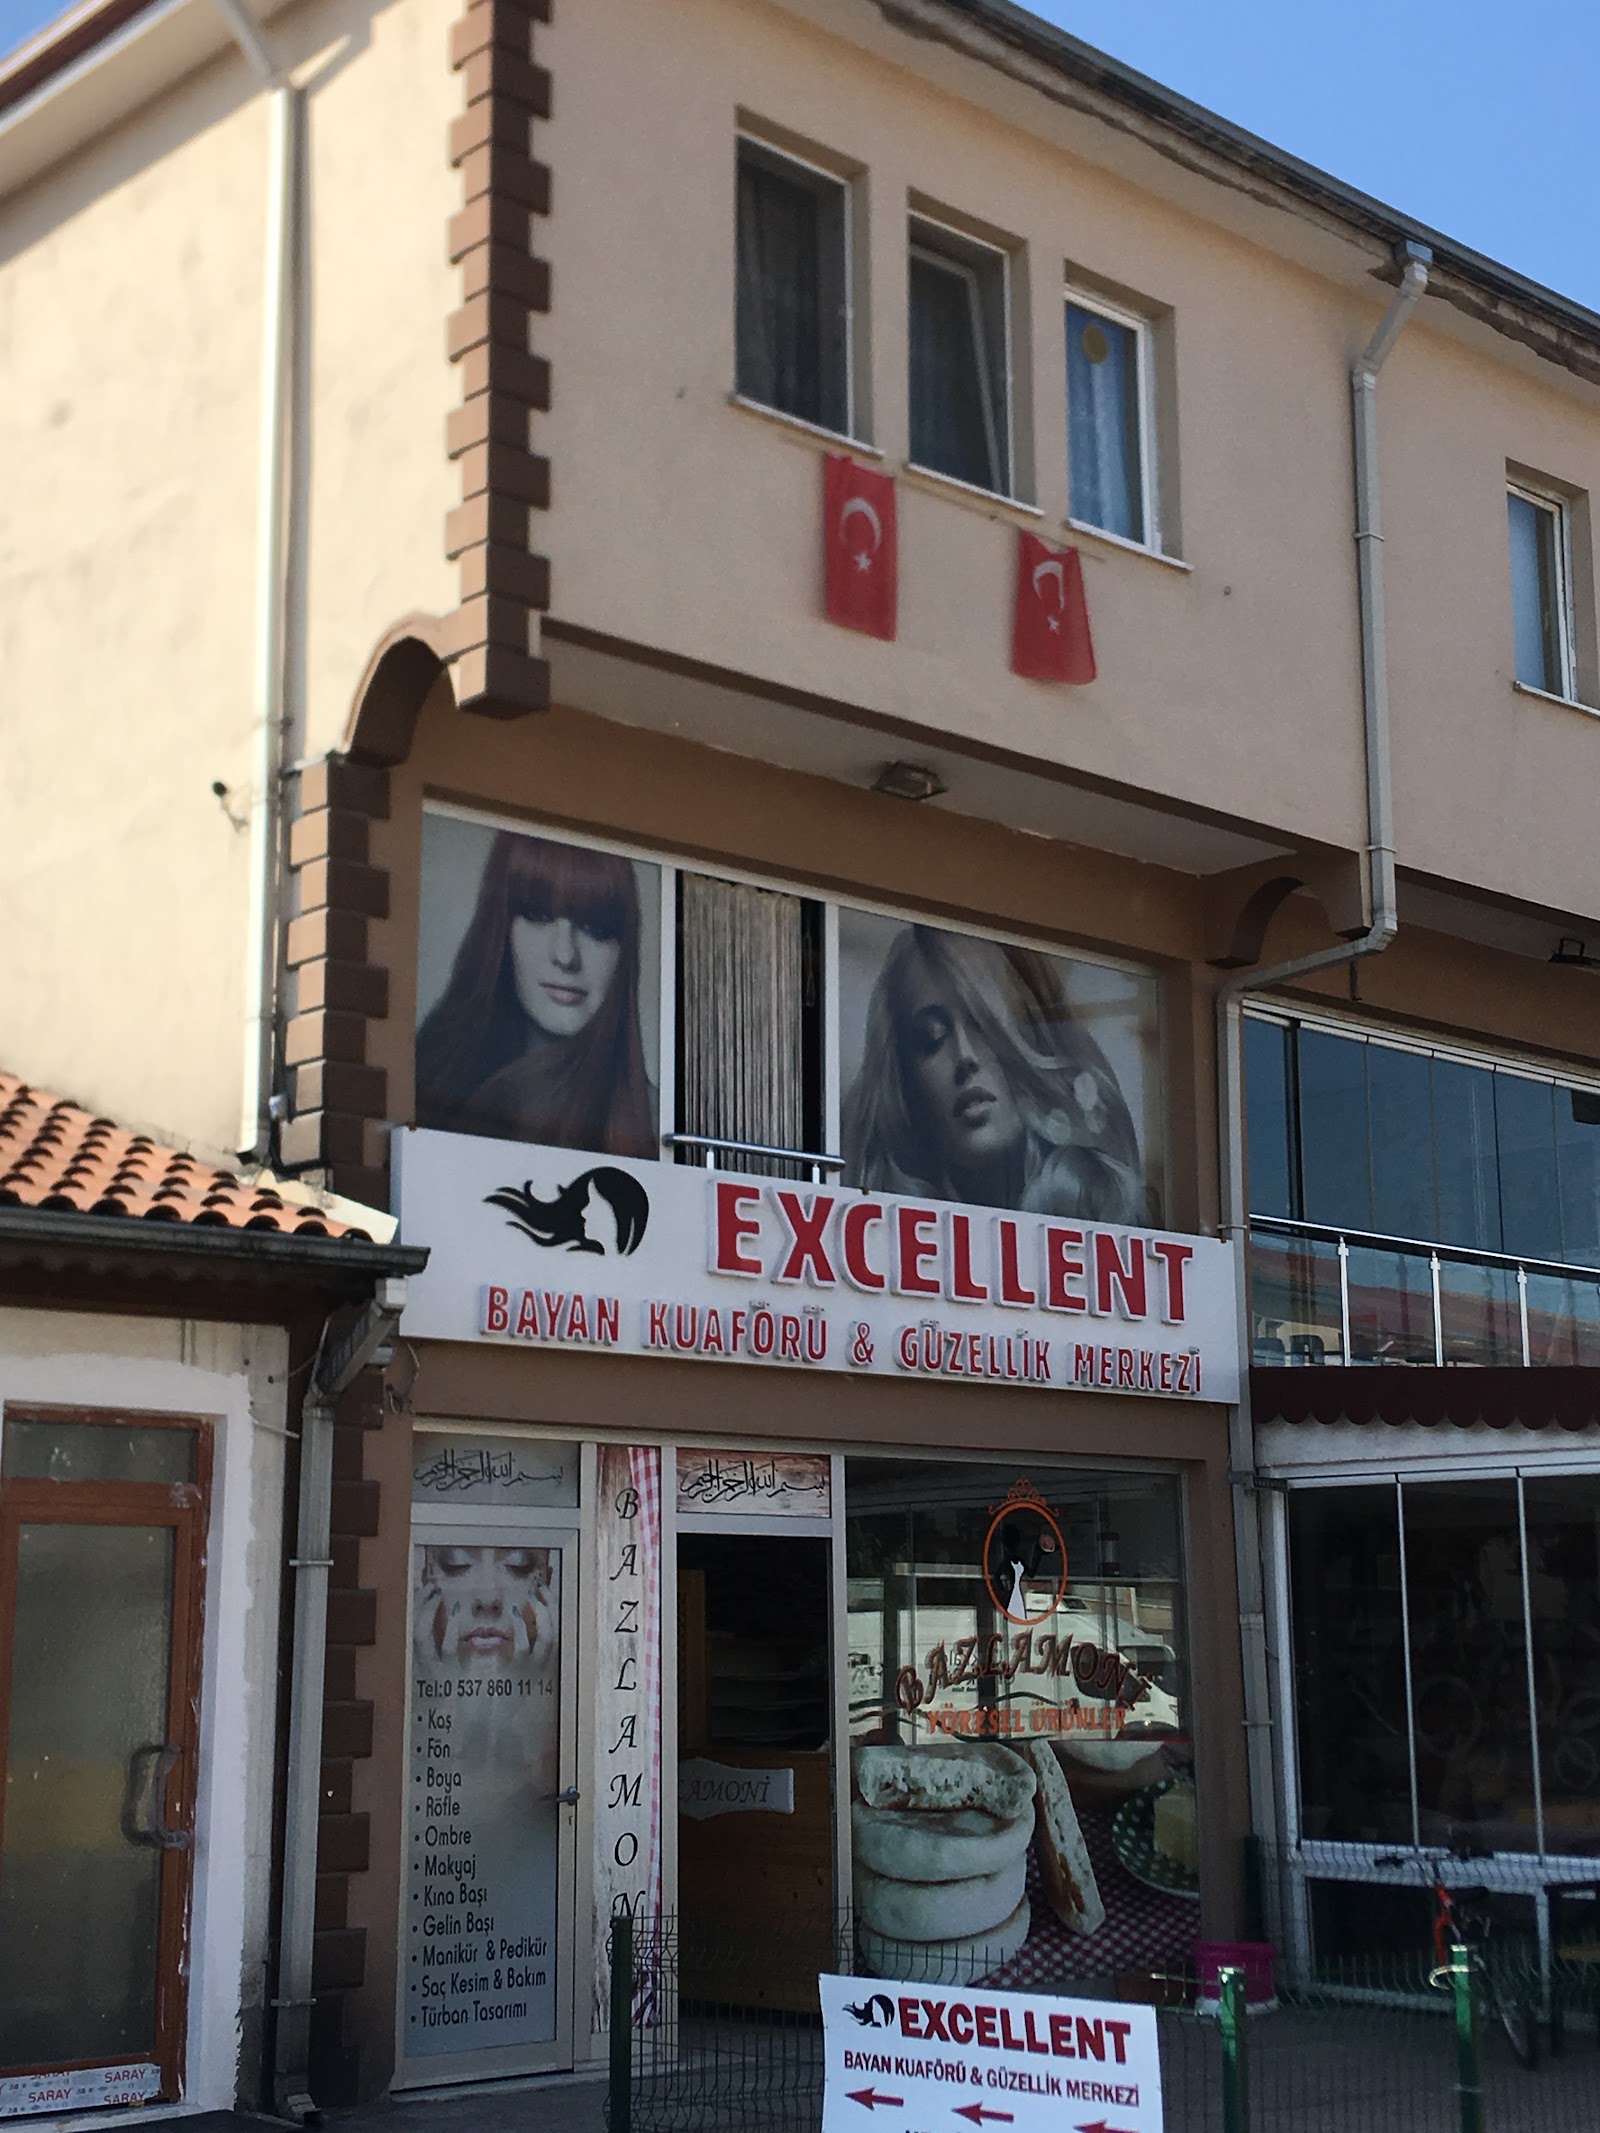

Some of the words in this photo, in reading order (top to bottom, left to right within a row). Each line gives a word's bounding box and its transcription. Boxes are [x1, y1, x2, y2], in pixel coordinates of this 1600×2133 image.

[712, 1180, 1196, 1325] EXCELLENT
[485, 1285, 620, 1343] BAYAN
[648, 1300, 828, 1361] KUAFÖRÜ
[852, 1321, 875, 1365] &
[899, 1320, 1051, 1380] GÜZELLİK
[1073, 1343, 1201, 1393] MERKEZİ
[457, 1679, 482, 1697] 537
[487, 1679, 512, 1697] 860
[518, 1679, 531, 1696] 11
[538, 1679, 553, 1695] 14
[428, 1708, 452, 1733] Kaş
[427, 1737, 450, 1758] Fön
[426, 1766, 462, 1793] Boya
[425, 1795, 461, 1818] Röfle
[425, 1825, 472, 1847] Ombre
[424, 1854, 476, 1881] Makyaj
[424, 1885, 455, 1907] Kına
[459, 1882, 487, 1908] Başı
[423, 1914, 461, 1937] Gelin
[466, 1911, 494, 1936] Başı
[423, 1942, 478, 1967] Manikür
[486, 1939, 495, 1961] &
[500, 1936, 547, 1960] Pedikür
[421, 1974, 446, 2001] Saç
[451, 1972, 489, 1995] Kesim
[494, 1968, 503, 1990] &
[507, 1966, 546, 1989] Bakım
[421, 2004, 468, 2028] Türban
[473, 2000, 527, 2023] Tasarımı
[897, 1996, 1132, 2064] EXCELLENT
[104, 2068, 146, 2083] SARAY
[844, 2050, 892, 2074] BAYAN
[895, 2057, 966, 2083] KUAFÖRÜ
[970, 2072, 983, 2087] &
[987, 2067, 1062, 2097] GÜZELLİK
[1067, 2081, 1140, 2108] MERKEZİ
[28, 2087, 72, 2103] SARAY
